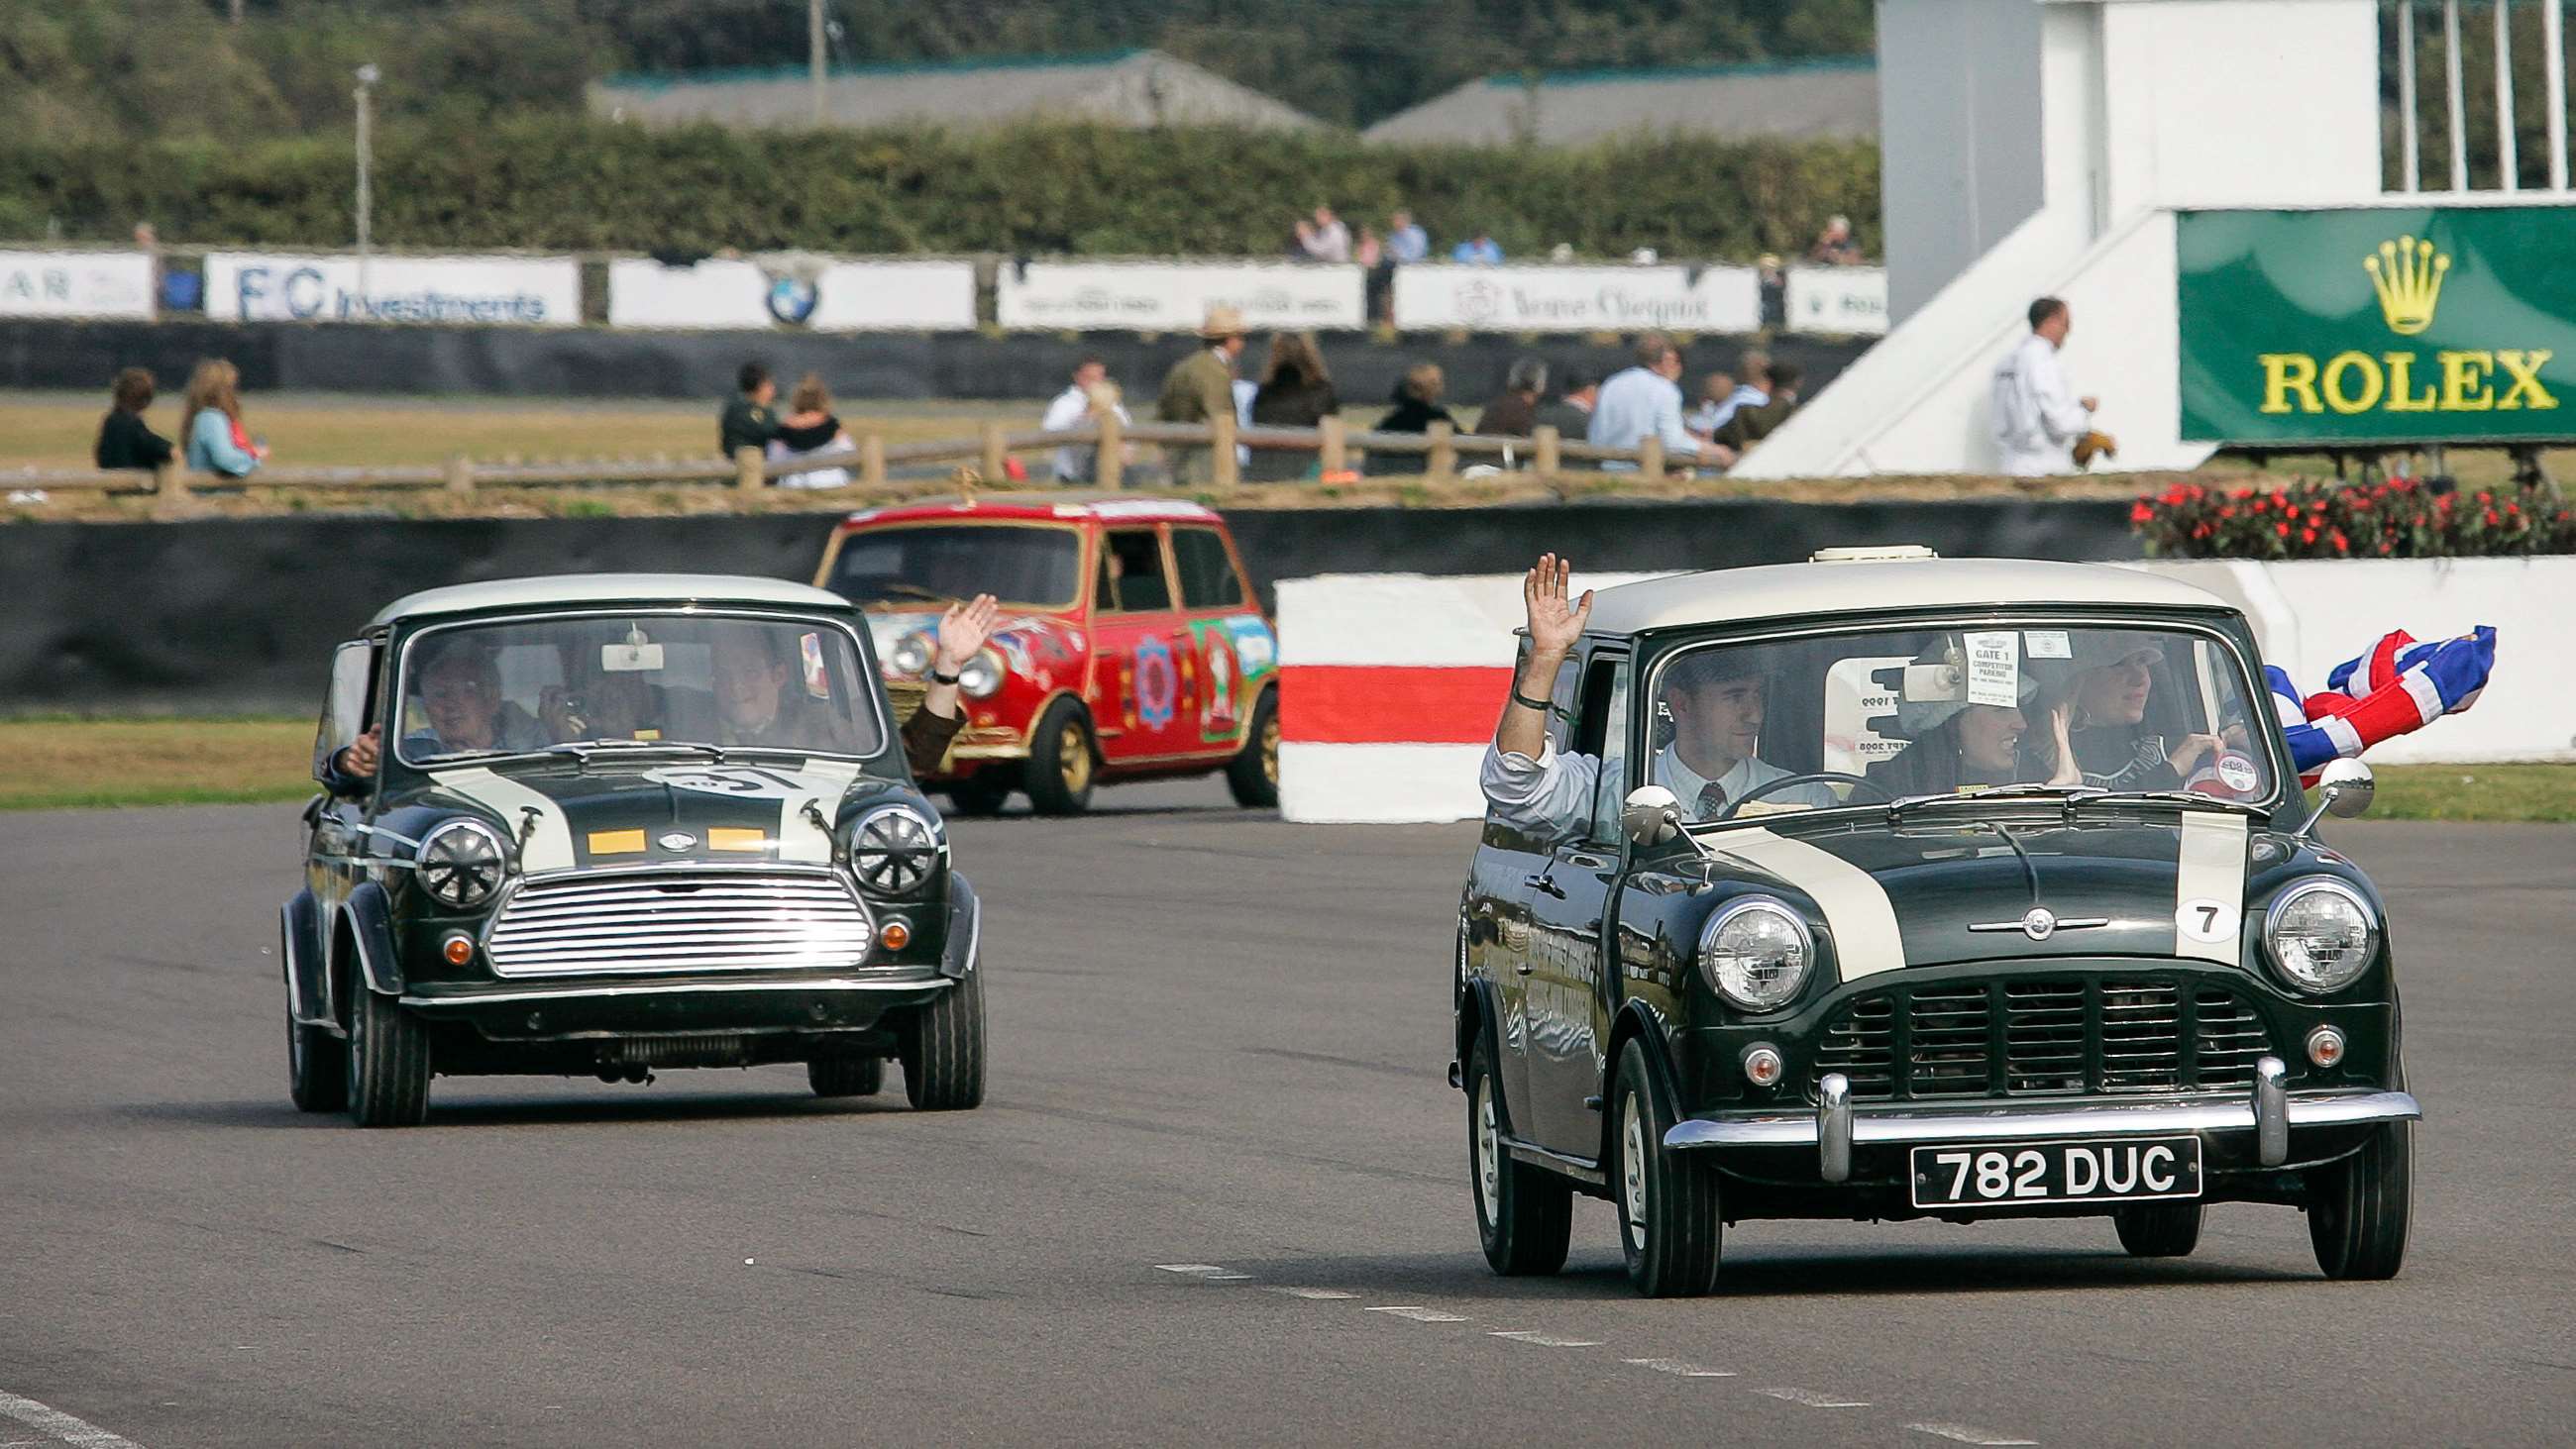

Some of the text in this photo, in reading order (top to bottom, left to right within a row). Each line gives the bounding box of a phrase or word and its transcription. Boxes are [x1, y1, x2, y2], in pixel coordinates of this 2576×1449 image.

[2258, 349, 2559, 414] ROLEX
[1976, 650, 2009, 662] GATE 1
[2196, 906, 2218, 933] 7
[1936, 1146, 2176, 1200] 782 DUC
